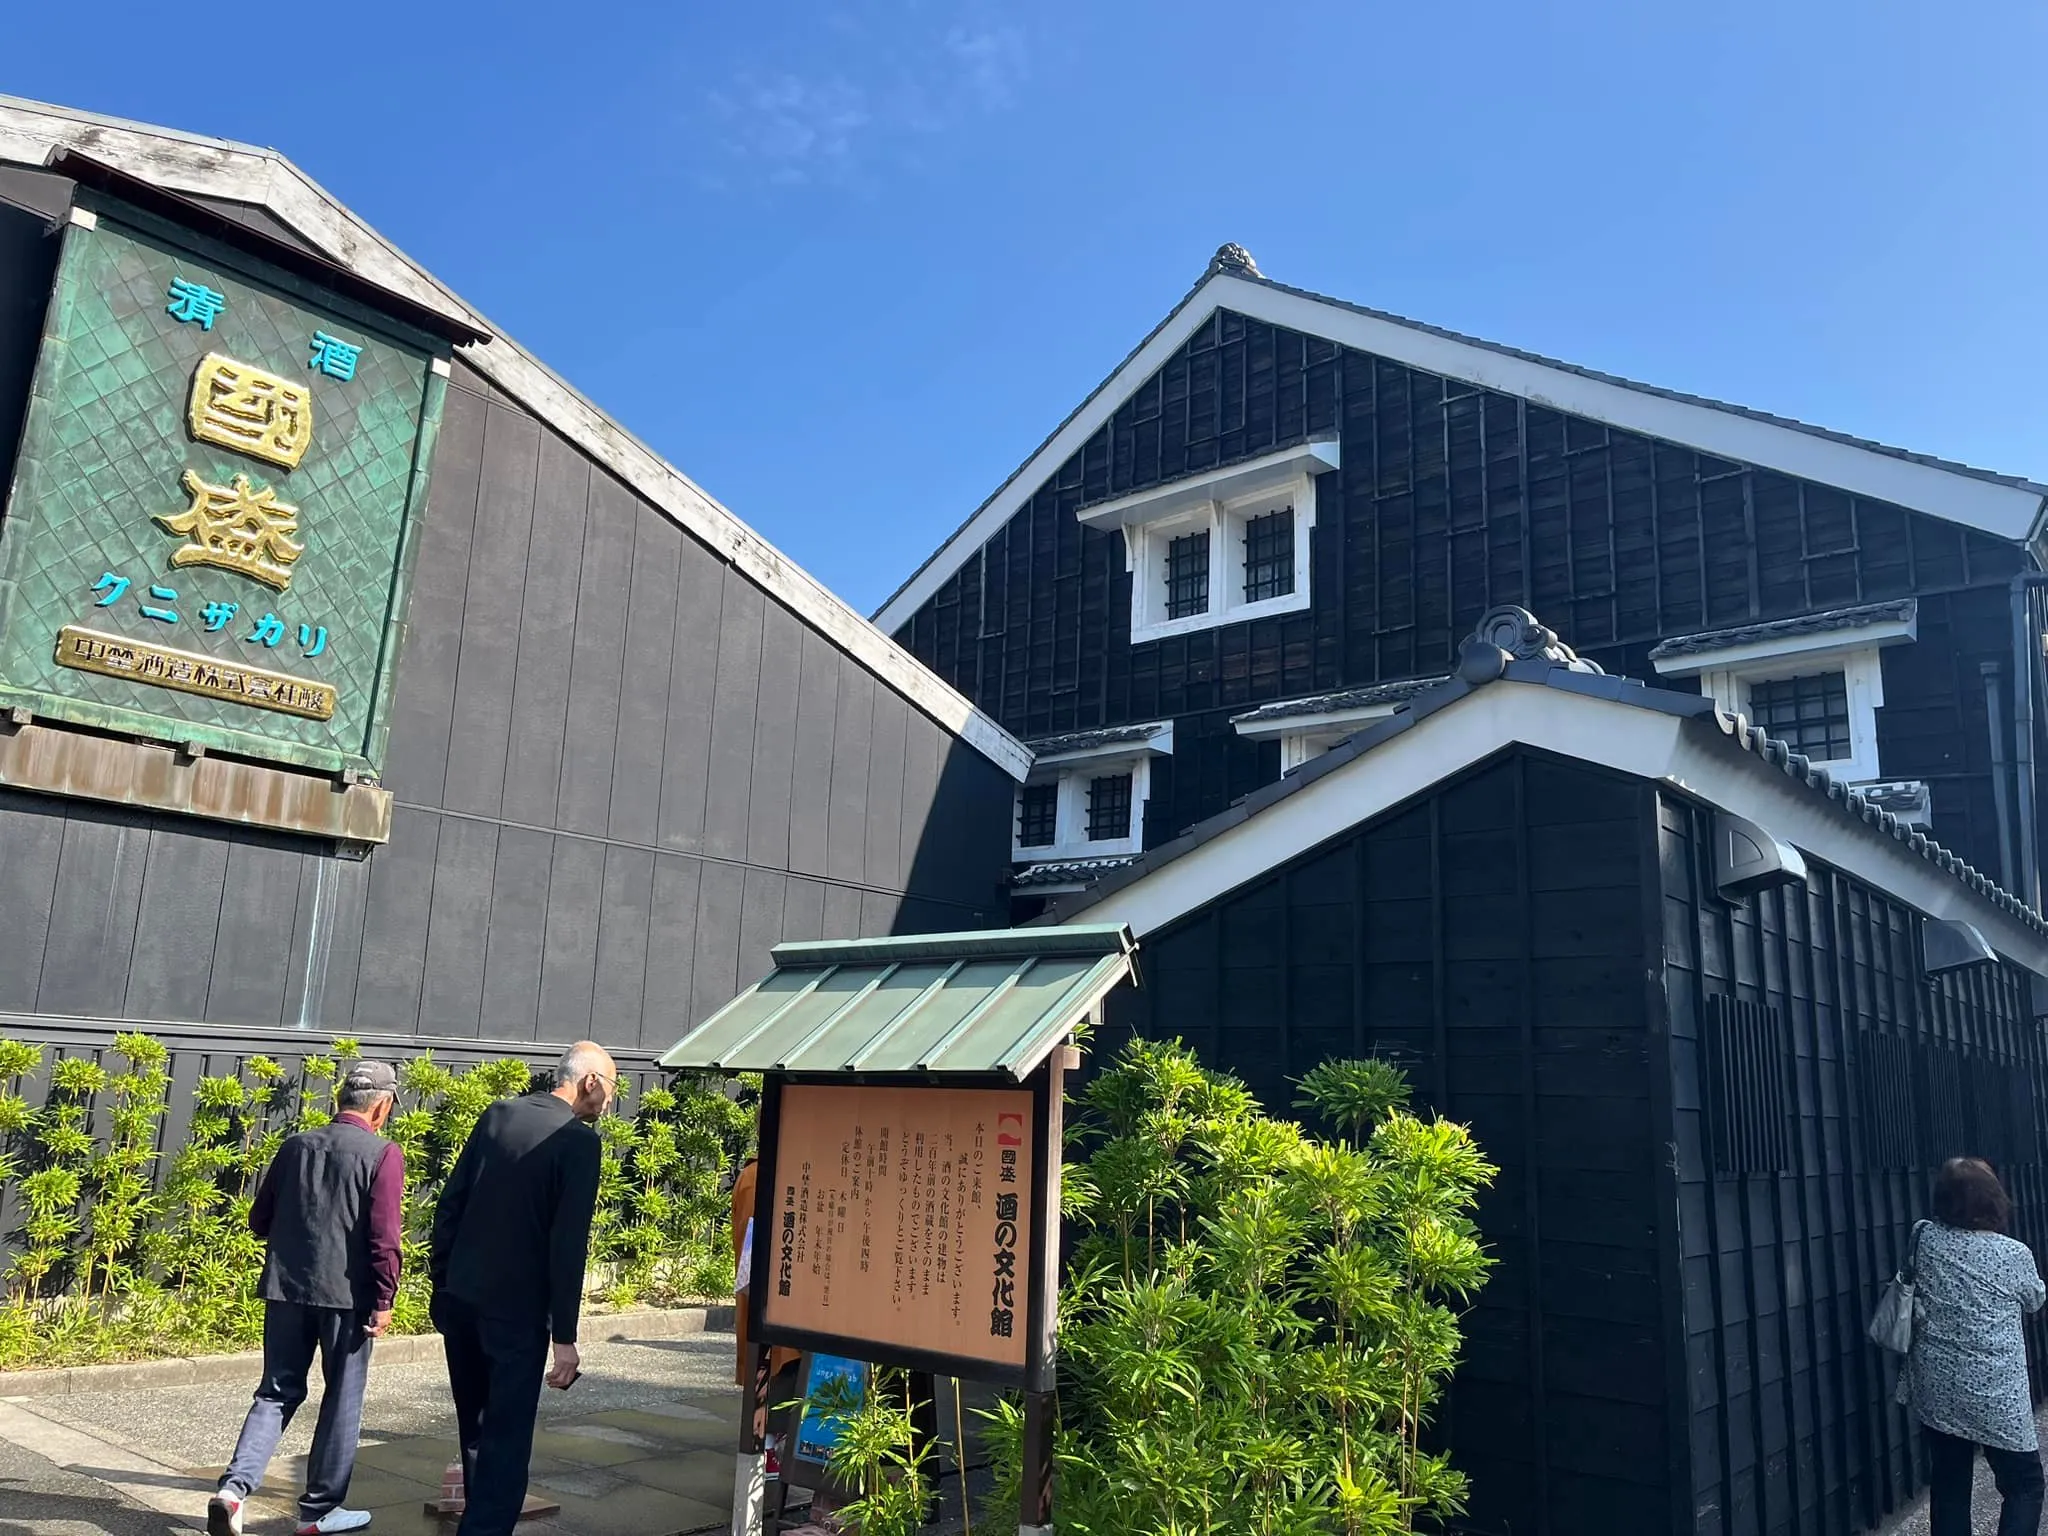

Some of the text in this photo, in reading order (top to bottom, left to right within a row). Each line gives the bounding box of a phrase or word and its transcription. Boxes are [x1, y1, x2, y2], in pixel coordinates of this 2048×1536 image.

[92, 572, 328, 657] クニザカリ
[990, 1192, 1019, 1338] 酒の文化館
